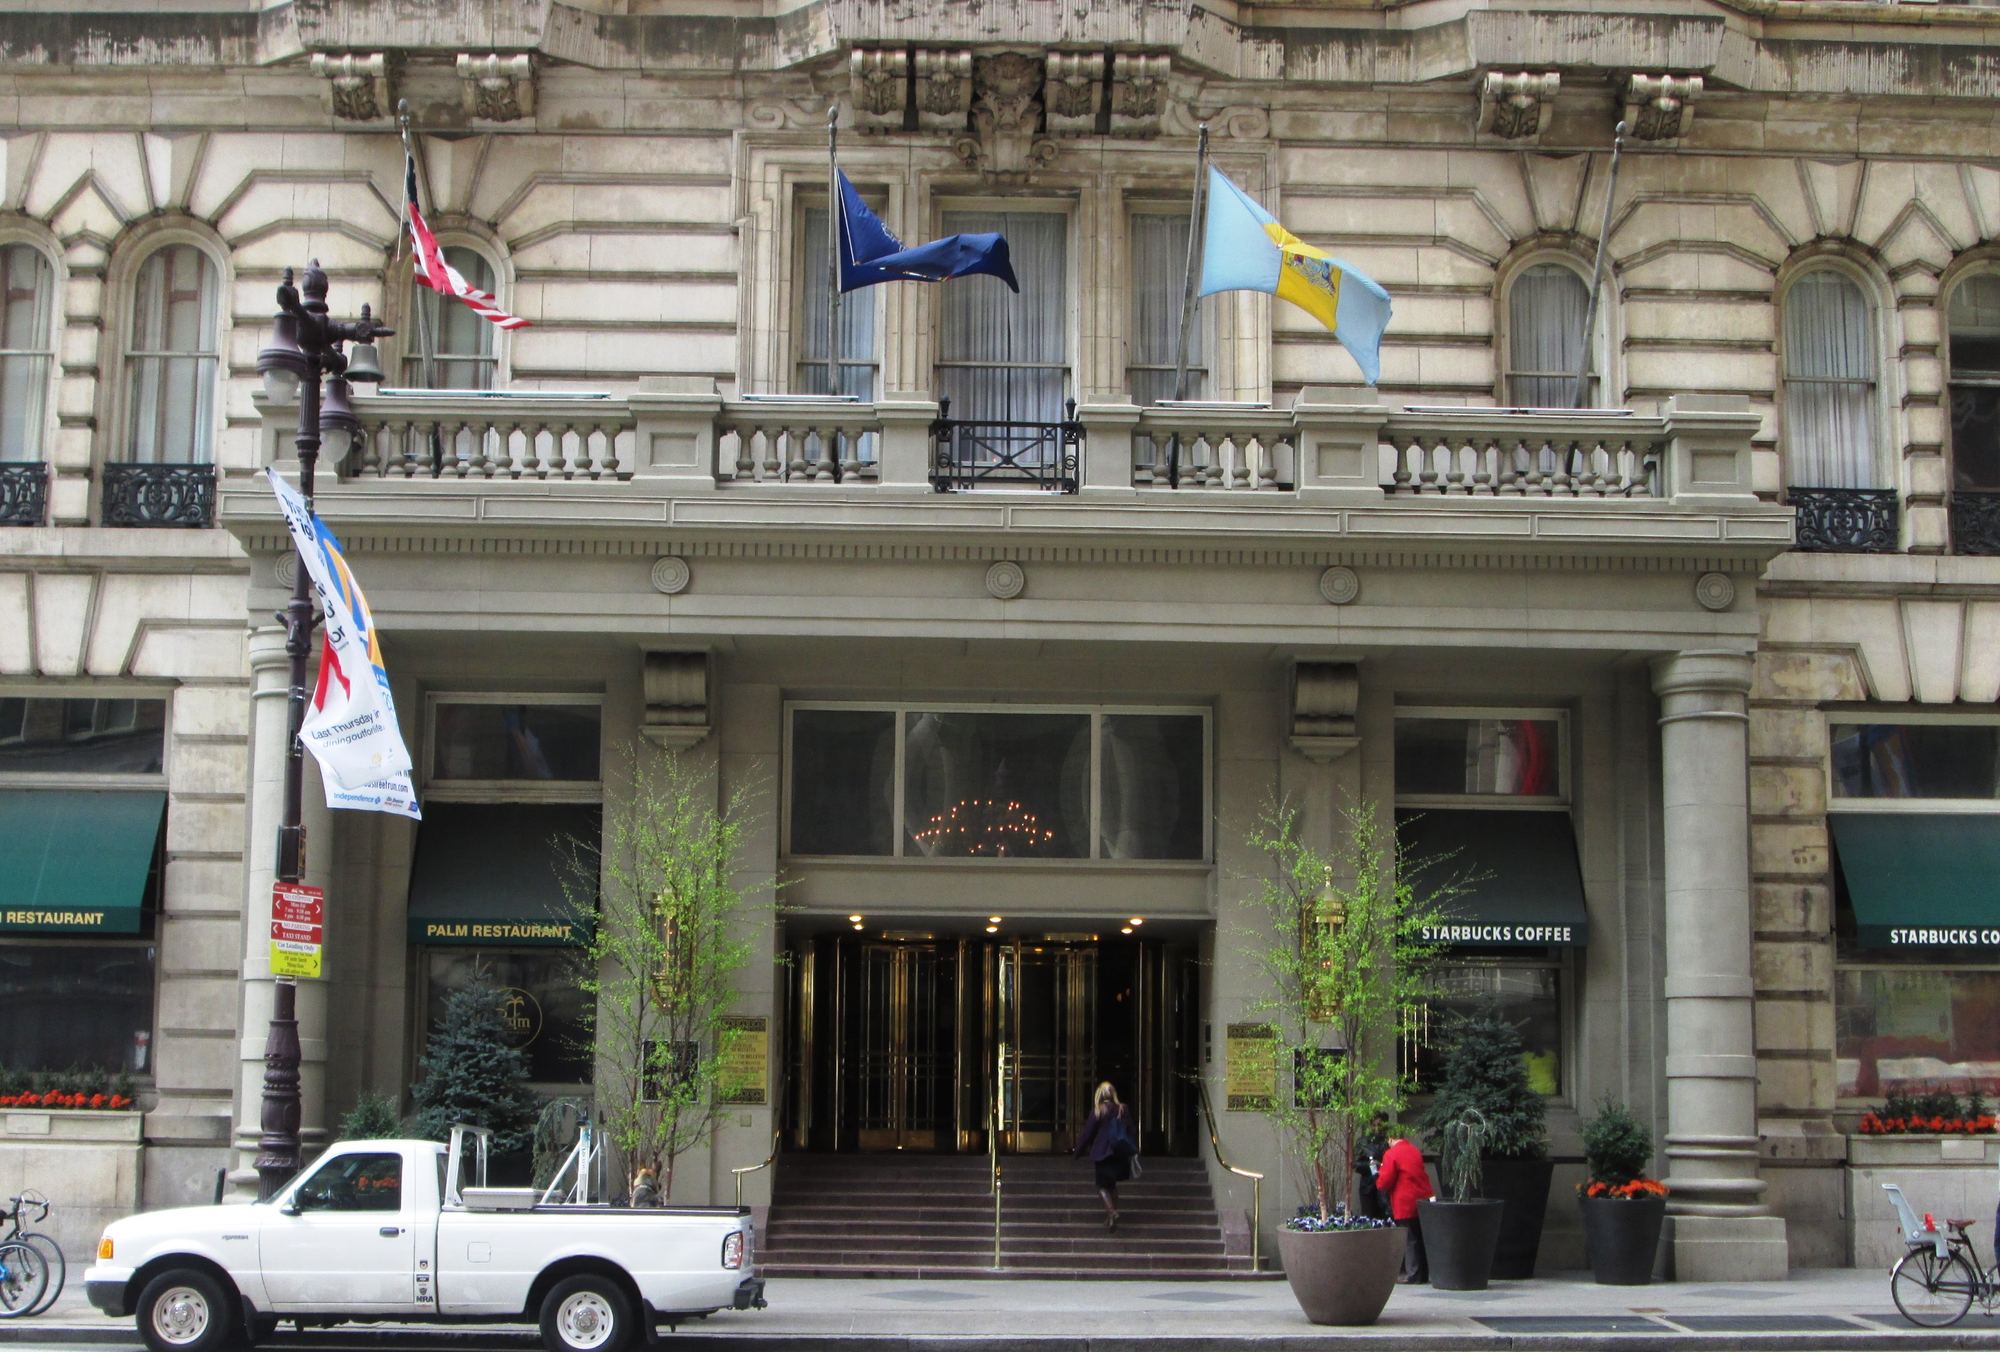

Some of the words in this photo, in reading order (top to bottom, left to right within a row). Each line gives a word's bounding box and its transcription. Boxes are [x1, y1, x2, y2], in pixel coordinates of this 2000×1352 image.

[311, 728, 331, 740] Last
[332, 713, 374, 734] Thursday
[334, 792, 375, 804] Independence
[6, 911, 104, 925] RESTAURANT
[427, 924, 468, 937] PALM
[472, 924, 572, 938] RESTAURANT
[1422, 925, 1511, 941] STARBUCKS
[1515, 926, 1571, 942] COFFEE
[1890, 929, 1977, 944] STARBUCKS
